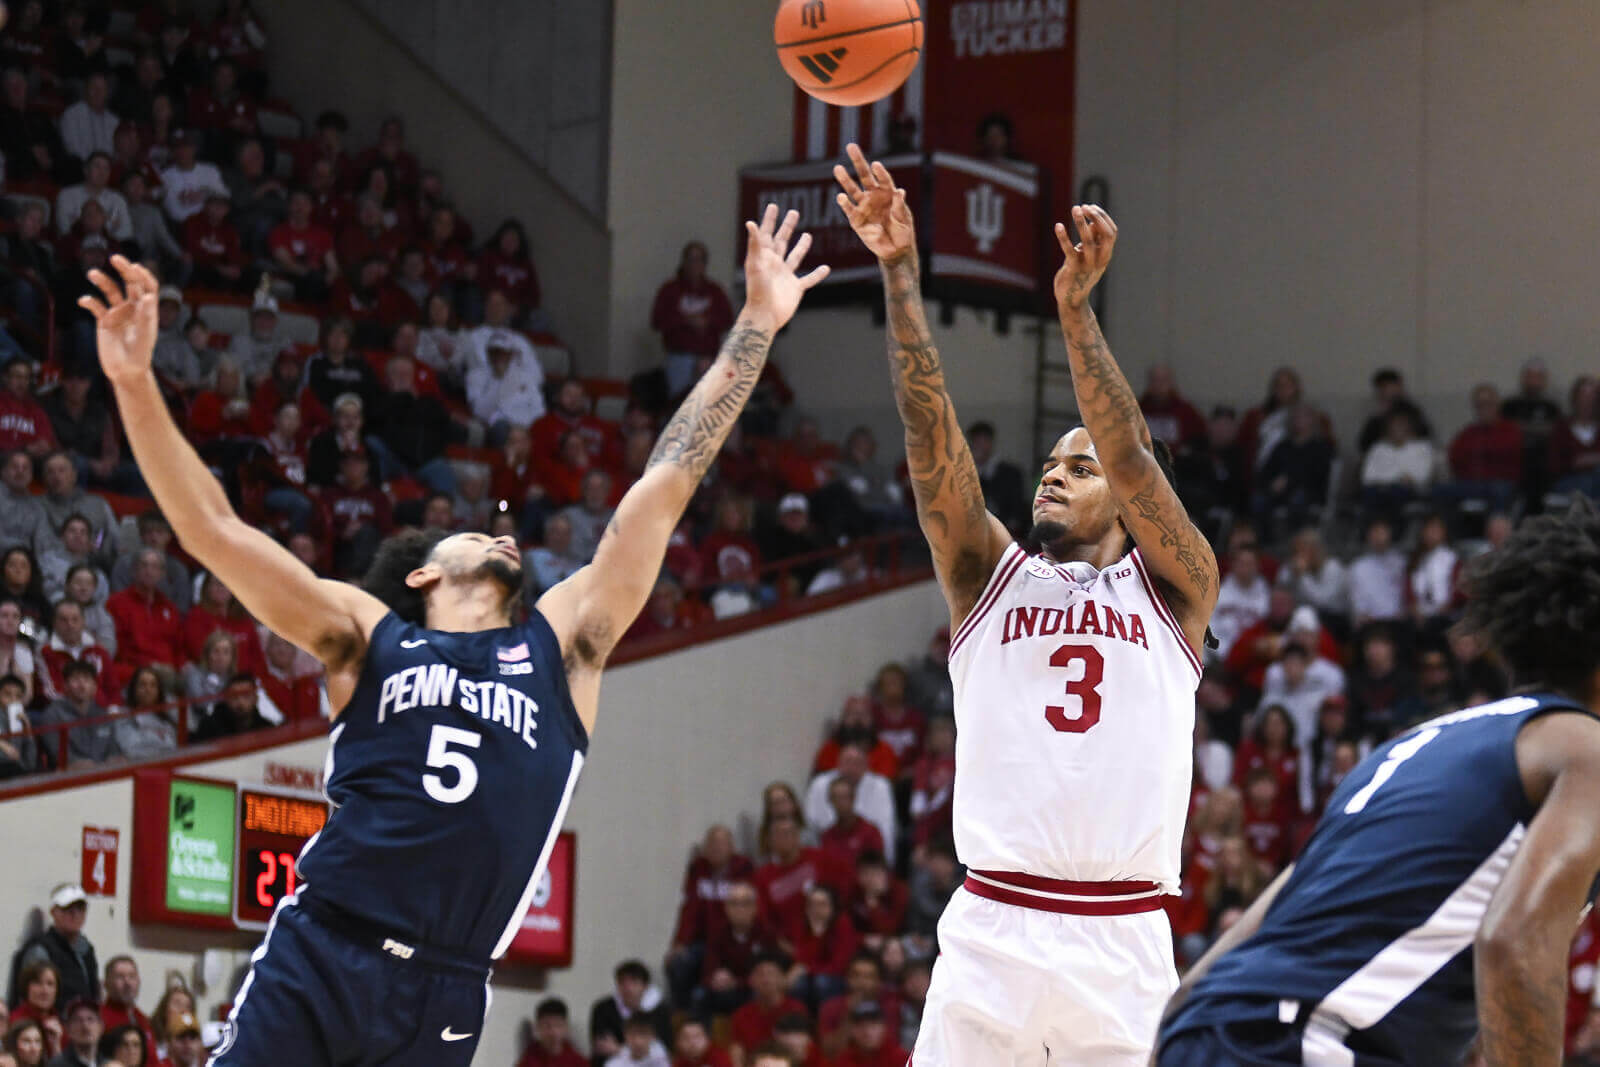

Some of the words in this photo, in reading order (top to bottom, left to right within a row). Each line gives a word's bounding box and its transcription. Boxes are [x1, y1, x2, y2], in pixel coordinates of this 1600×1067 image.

[1001, 600, 1149, 651] INDIANA
[376, 663, 459, 724] PENN
[458, 678, 540, 750] STATE
[1044, 644, 1105, 734] 3
[421, 724, 483, 804] 5
[92, 851, 106, 890] 4
